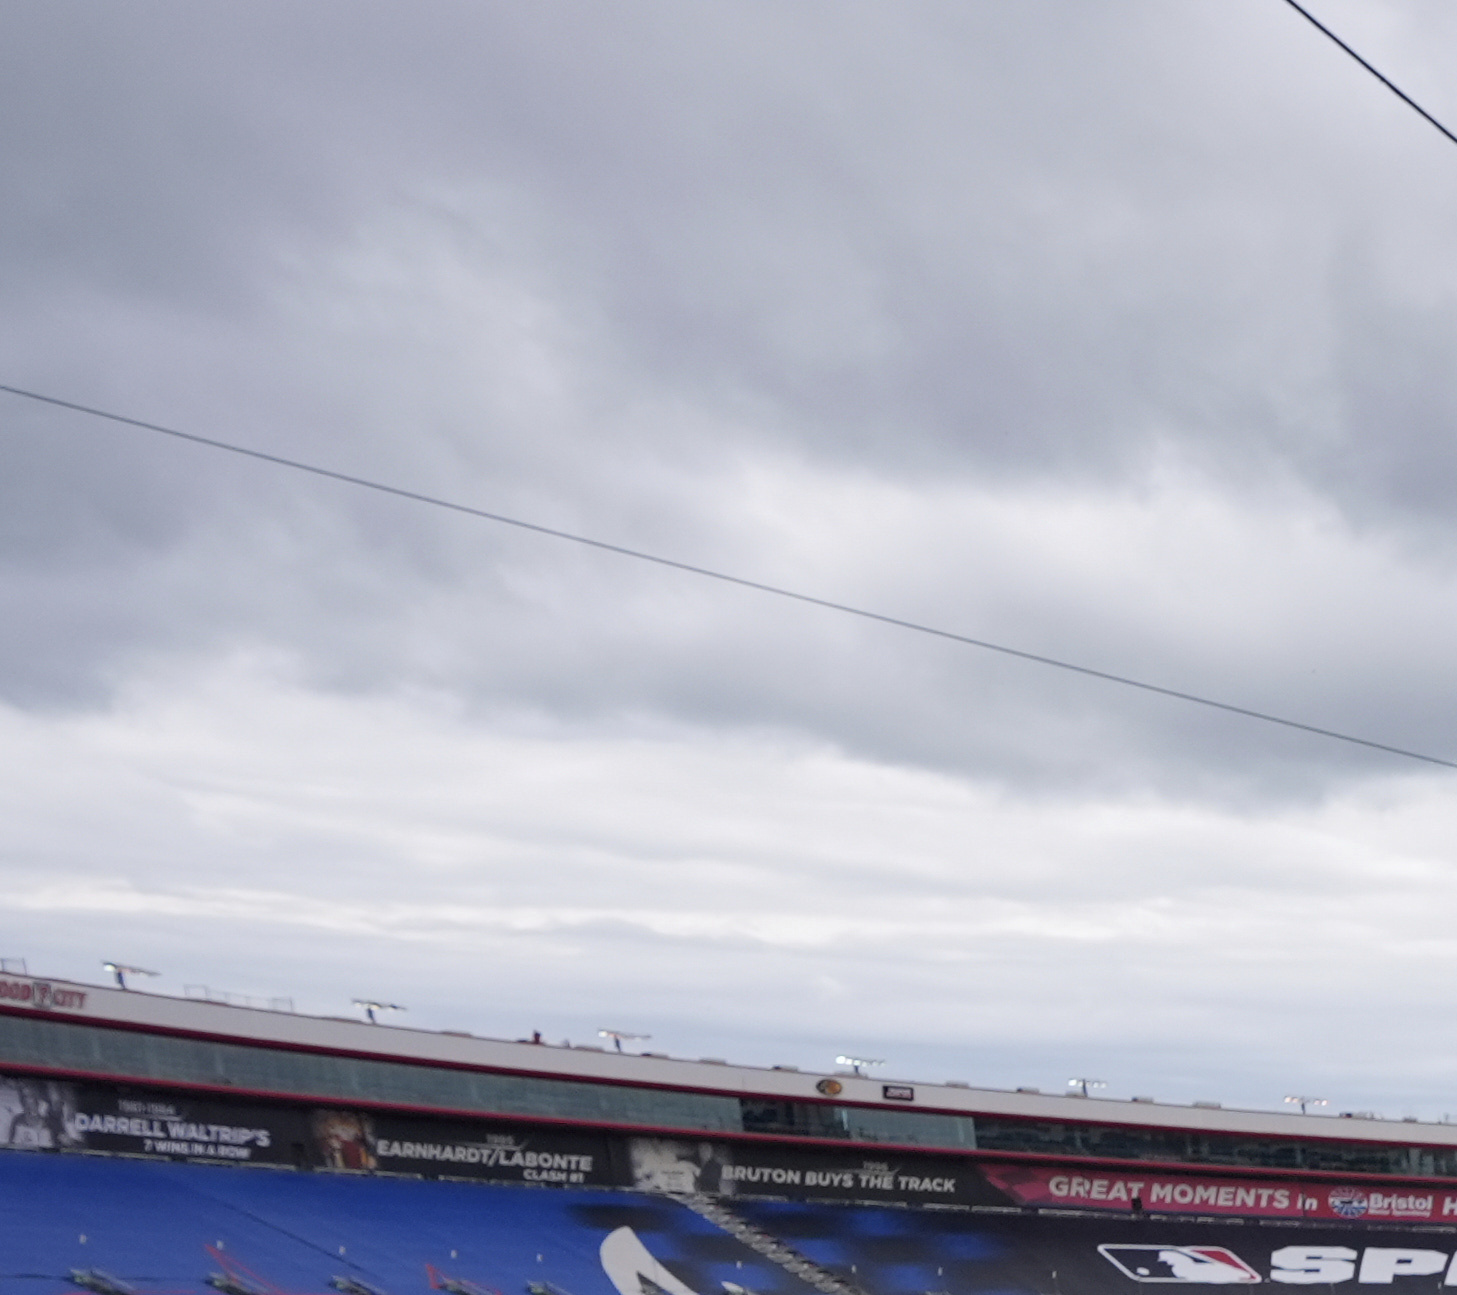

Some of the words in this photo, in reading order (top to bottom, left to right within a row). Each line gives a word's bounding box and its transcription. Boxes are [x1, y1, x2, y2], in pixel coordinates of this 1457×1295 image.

[75, 1113, 167, 1139] DARRELL
[168, 1121, 271, 1147] WALTRIP'S
[377, 1140, 593, 1171] EARNHARDT/LABONTE
[523, 1170, 567, 1182] CLASH
[721, 1164, 801, 1184] BRUTON
[805, 1171, 853, 1188] BUYS
[860, 1173, 894, 1189] THE
[899, 1176, 956, 1192] TRACK
[1050, 1175, 1144, 1201] GREAT
[1151, 1182, 1290, 1209] MOMENTS
[1296, 1193, 1318, 1211] in
[1369, 1193, 1434, 1211] Bristol
